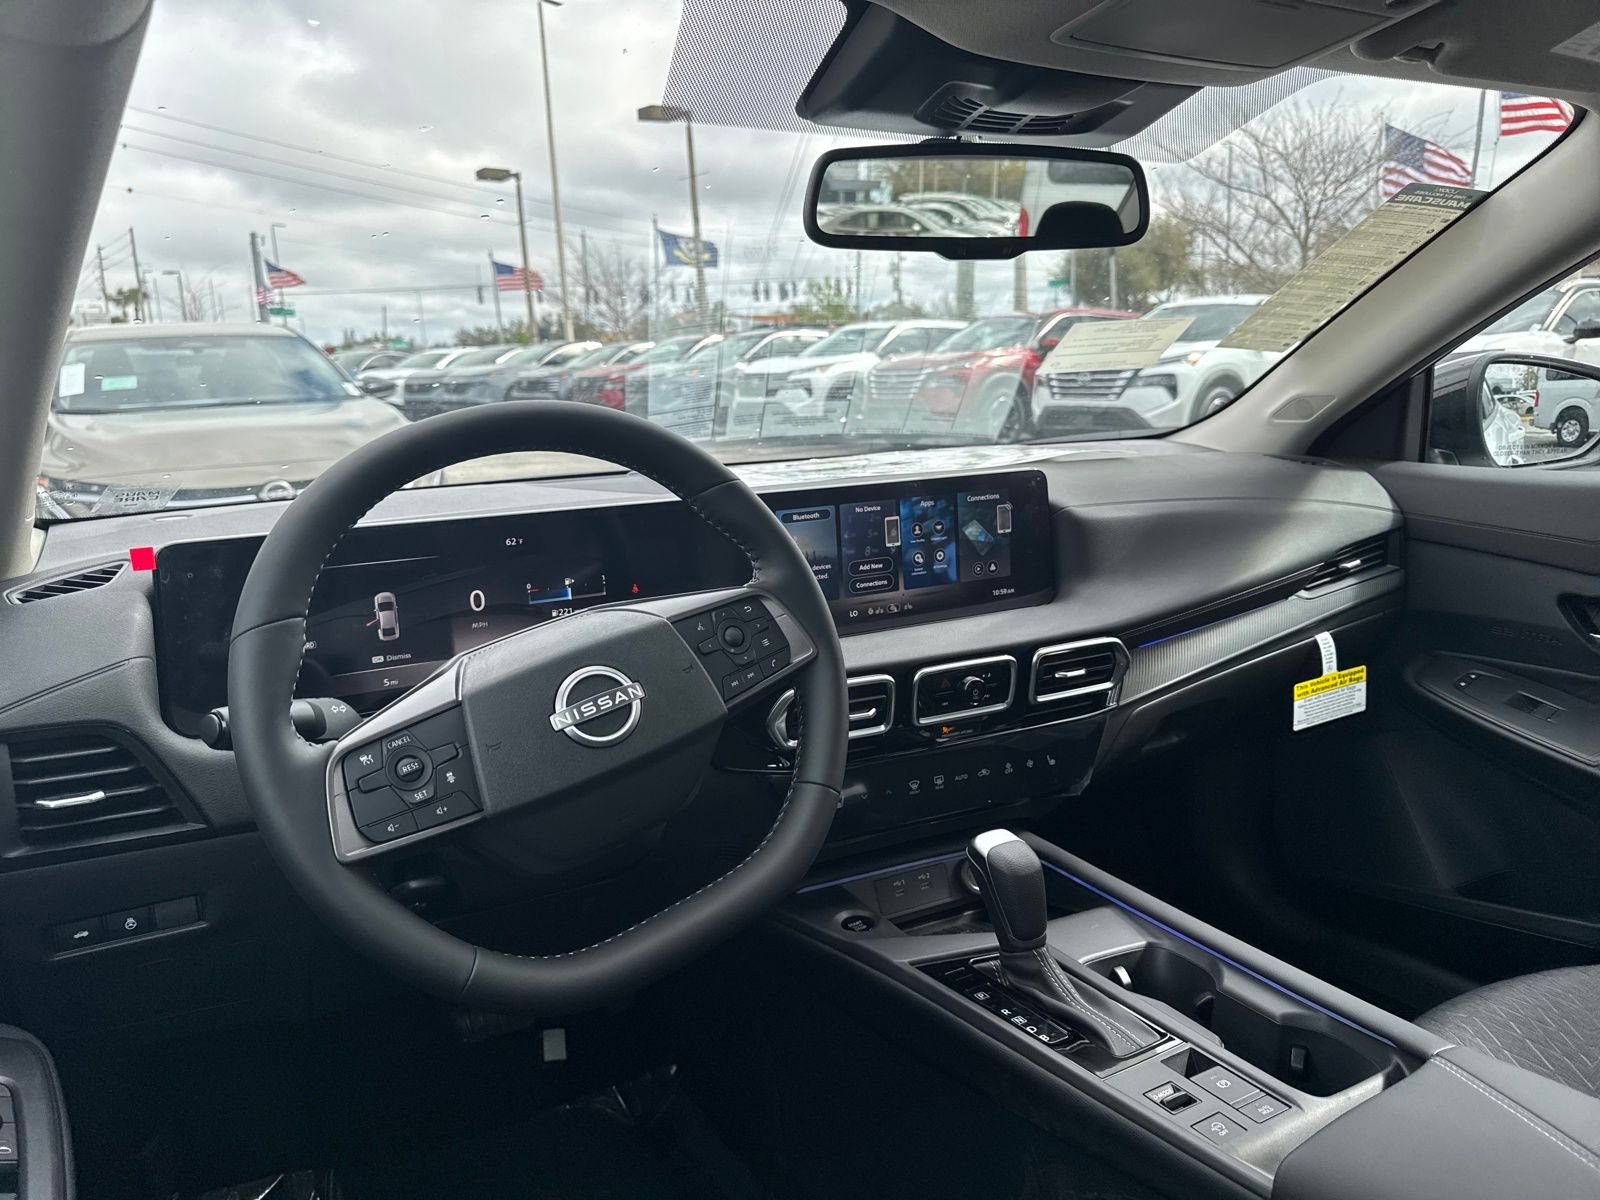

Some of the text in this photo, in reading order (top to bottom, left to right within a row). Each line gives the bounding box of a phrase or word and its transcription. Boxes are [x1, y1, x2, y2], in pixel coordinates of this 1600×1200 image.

[966, 493, 1000, 502] Connections
[864, 504, 881, 512] Device
[920, 500, 935, 508] Apps
[792, 512, 820, 521] Bluetooth
[811, 563, 832, 571] devices
[859, 562, 883, 571] Add New
[856, 579, 888, 589] Connections
[469, 589, 486, 612] 0
[558, 607, 573, 616] 221
[471, 621, 489, 630] MPH
[386, 653, 412, 662] Dismiss
[384, 678, 390, 687] 5
[1296, 684, 1309, 692] This
[1310, 678, 1331, 688] Vehicle
[1338, 668, 1364, 679] Equipped
[1297, 675, 1363, 698] with Advanced Air Bags
[553, 685, 643, 729] NISSAN
[387, 735, 411, 750] CANCEL
[954, 773, 969, 781] AUTO
[414, 789, 428, 801] SET
[1000, 1008, 1012, 1016] R
[1026, 1025, 1037, 1034] D
[1040, 1034, 1050, 1042] B
